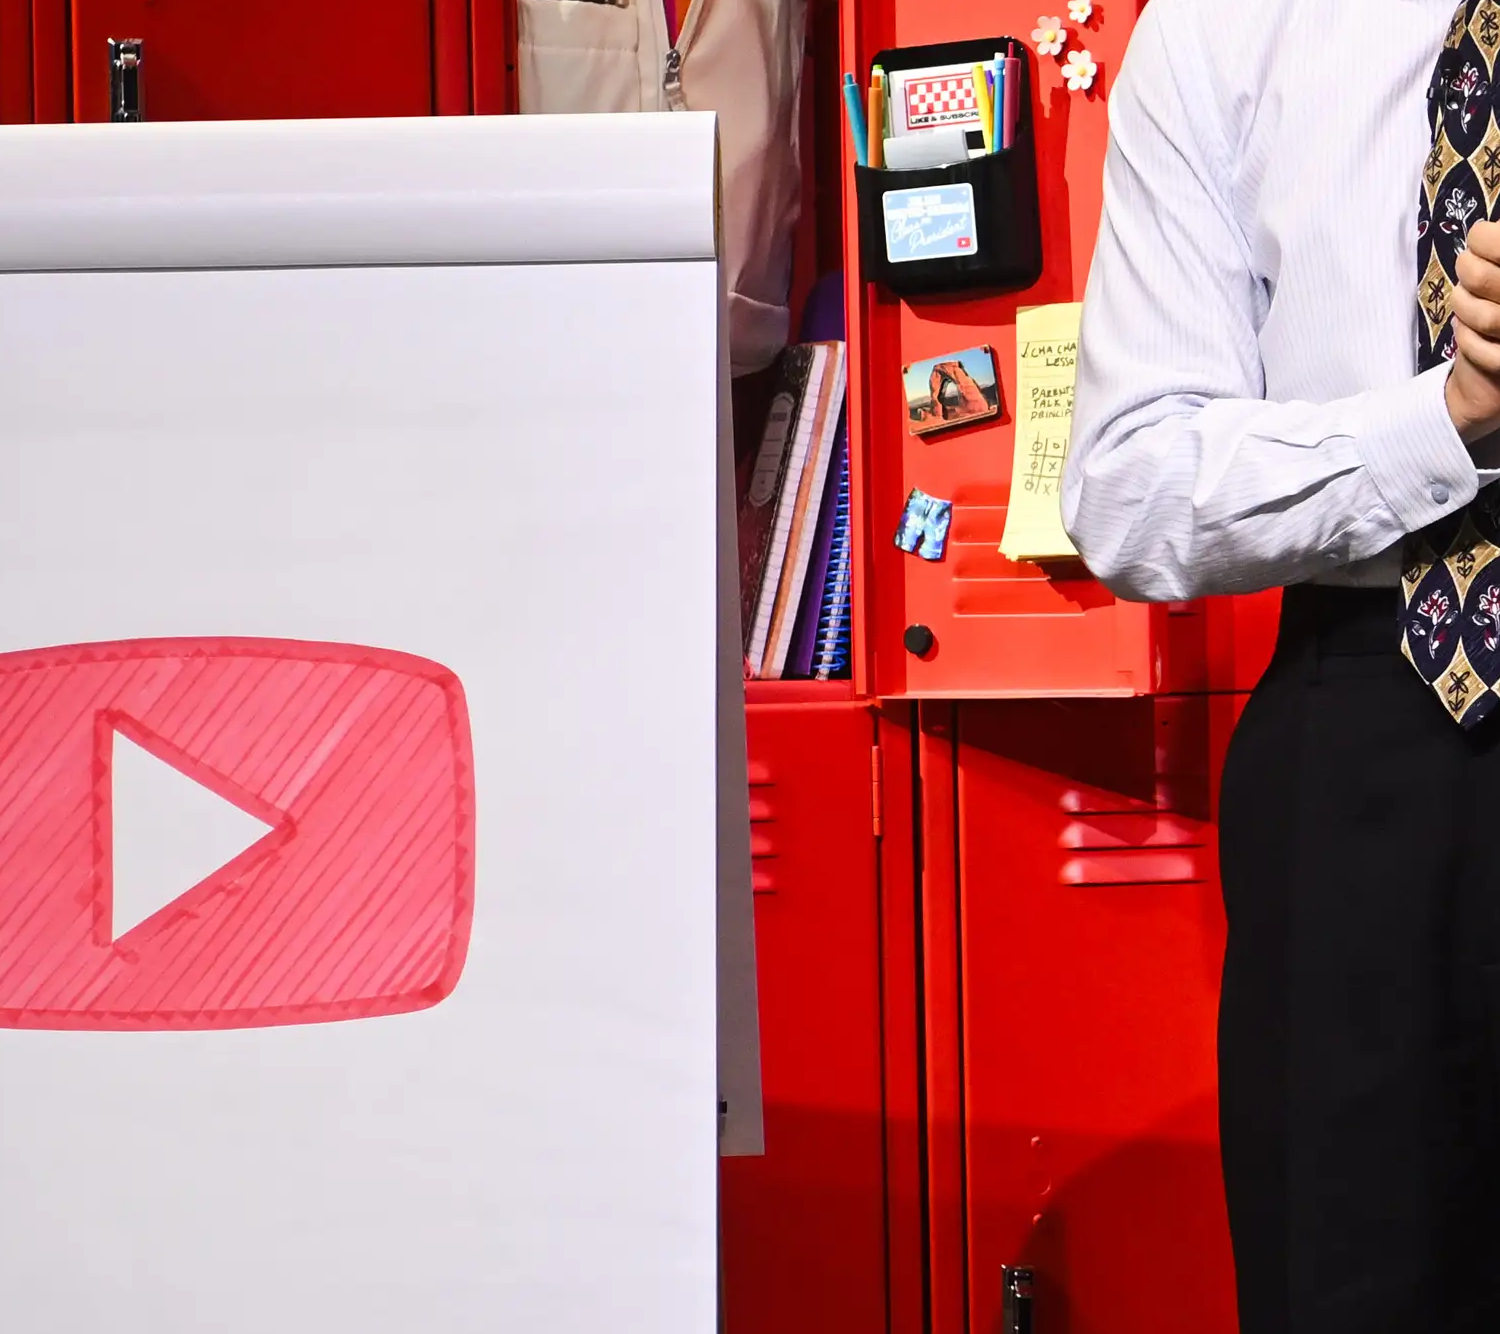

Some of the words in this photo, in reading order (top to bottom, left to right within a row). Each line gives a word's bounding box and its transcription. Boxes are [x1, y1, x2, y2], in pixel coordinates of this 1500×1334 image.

[910, 116, 929, 124] LIKE
[1031, 346, 1053, 358] CHA
[1057, 342, 1077, 354] CHA
[1046, 357, 1074, 367] LESSO
[1033, 398, 1061, 408] TALK
[1031, 408, 1073, 421] PRINCIP
